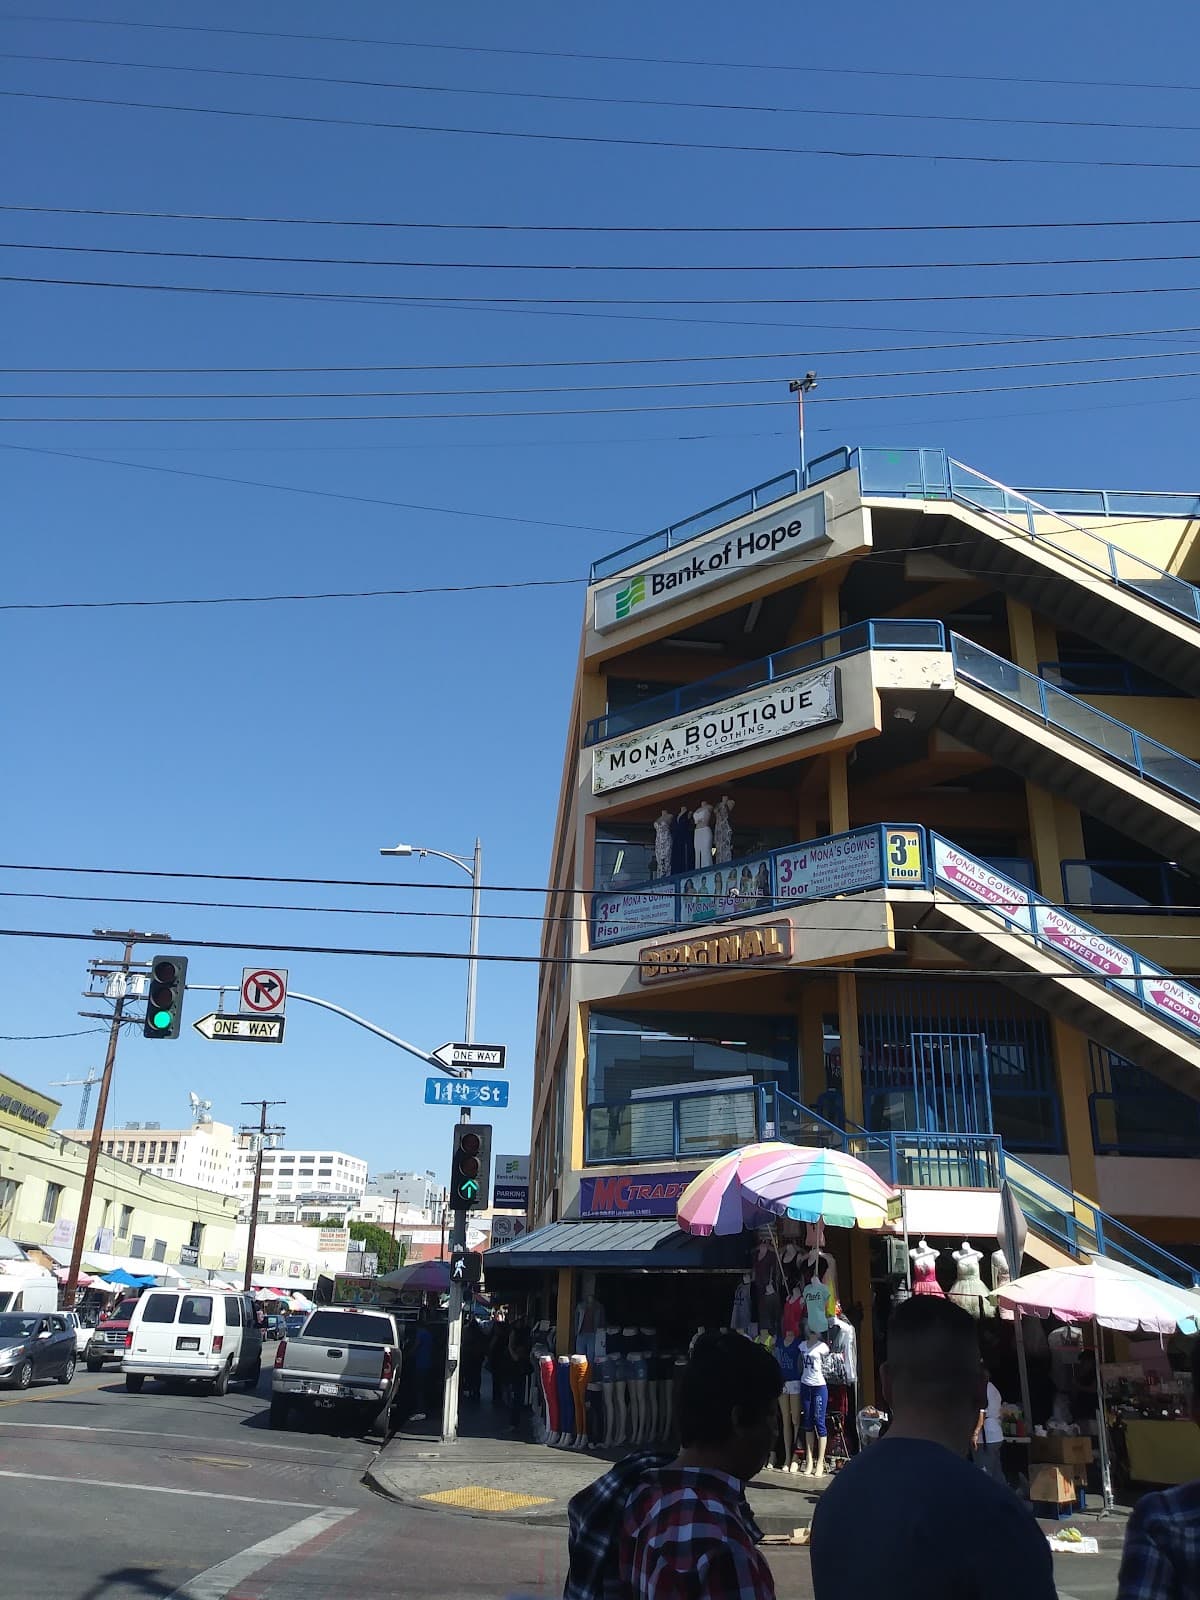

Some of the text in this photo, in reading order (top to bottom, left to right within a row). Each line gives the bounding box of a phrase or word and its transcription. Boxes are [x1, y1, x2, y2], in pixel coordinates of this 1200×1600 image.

[652, 519, 802, 596] Bank of Hope
[609, 690, 814, 771] MONA BOUTIQUE
[649, 723, 765, 766] WOMEN'S CLOTHING
[810, 838, 875, 863] MONA'S GOWNS
[890, 834, 917, 866] 3rd
[780, 855, 807, 883] 3rd
[891, 867, 918, 877] Floor
[946, 850, 1025, 903] MONA'S GOWNS
[781, 884, 809, 897] Floor
[955, 872, 985, 894] BRIDES
[600, 902, 621, 923] 3er
[597, 926, 619, 937] Piso
[1046, 911, 1129, 966] MONA'S GOWNS
[642, 927, 784, 977] ORIGINAL
[1062, 937, 1110, 971] SWEET 16
[1162, 996, 1190, 1017] PROM
[213, 1020, 276, 1036] ONE WAY
[453, 1050, 498, 1061] ONE WAY
[479, 1085, 500, 1102] St
[496, 1190, 526, 1198] PARKING
[591, 1176, 691, 1211] MC TRADI
